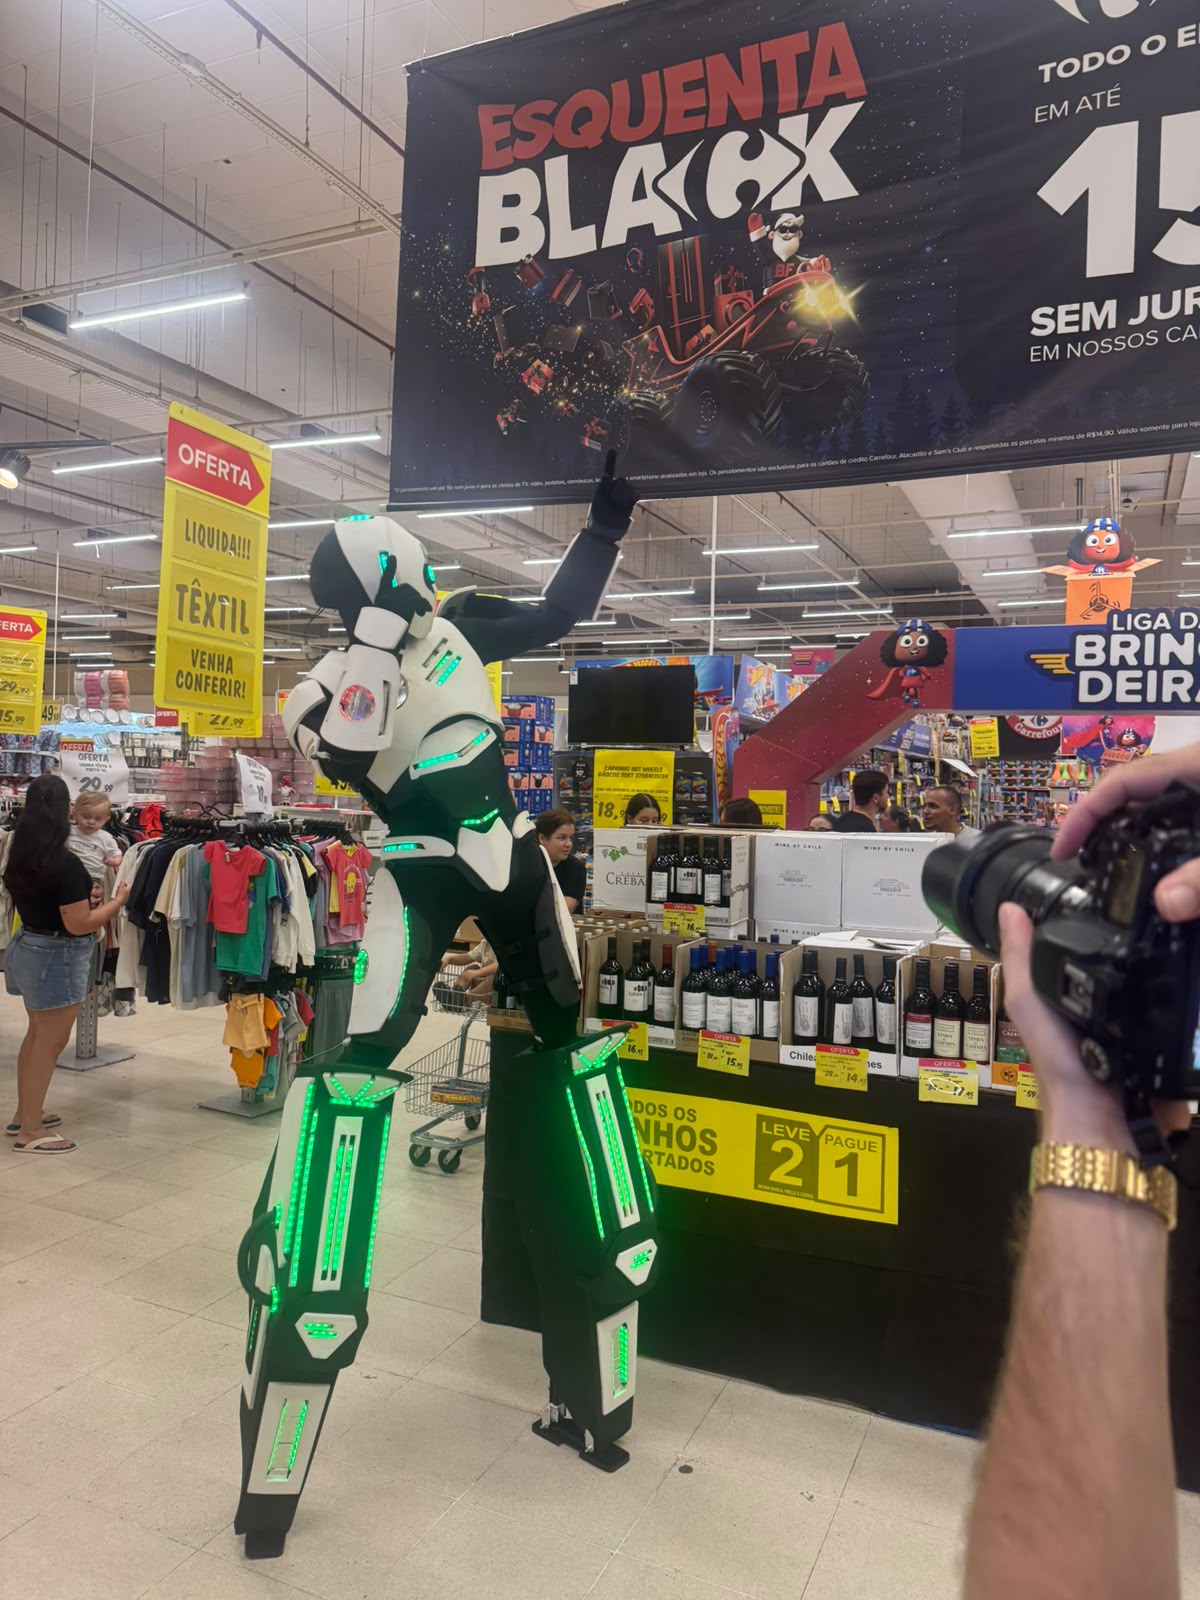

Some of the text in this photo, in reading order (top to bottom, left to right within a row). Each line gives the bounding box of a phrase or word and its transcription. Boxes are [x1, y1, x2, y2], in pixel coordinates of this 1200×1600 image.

[1038, 43, 1131, 84] TODO
[1140, 34, 1167, 55] O
[477, 21, 868, 170] ESQUENTA
[1034, 84, 1122, 123] EM ATÉ
[474, 100, 866, 268] BLACK
[774, 262, 794, 279] BF
[1030, 299, 1117, 337] SEM
[1030, 323, 1200, 363] EM NOSSOS CA
[718, 467, 756, 476] parcelamentos
[768, 463, 796, 471] exclusivos
[797, 462, 809, 470] para
[818, 459, 838, 467] cartões
[848, 456, 868, 464] crédito
[869, 454, 897, 462] Carrefour,
[899, 450, 927, 459] Atacadão
[933, 447, 952, 456] Sam's
[1019, 437, 1046, 447] parcelas
[1117, 426, 1138, 435] Válido
[1140, 424, 1170, 433] somente
[1172, 422, 1188, 431] para
[178, 443, 252, 491] OFERTA
[184, 518, 251, 561] LIQUIDA!!!
[175, 577, 250, 635] TÊXTIL
[1112, 612, 1200, 631] LIGA D
[190, 649, 234, 675] VENHA
[1075, 633, 1200, 667] BRIN
[175, 667, 246, 700] CONFERIR!
[155, 710, 178, 718] OFERTA
[62, 743, 93, 752] OFERTA
[78, 752, 109, 763] OFERTA
[714, 1033, 738, 1042] OFERTA
[830, 1046, 856, 1056] OFERTA
[934, 1060, 961, 1068] OFERTA
[630, 1099, 697, 1123] DOS OS
[762, 1121, 811, 1142] LEVE
[824, 1133, 878, 1153] PAGUE
[768, 1139, 804, 1187] 2
[834, 1152, 859, 1197] 1
